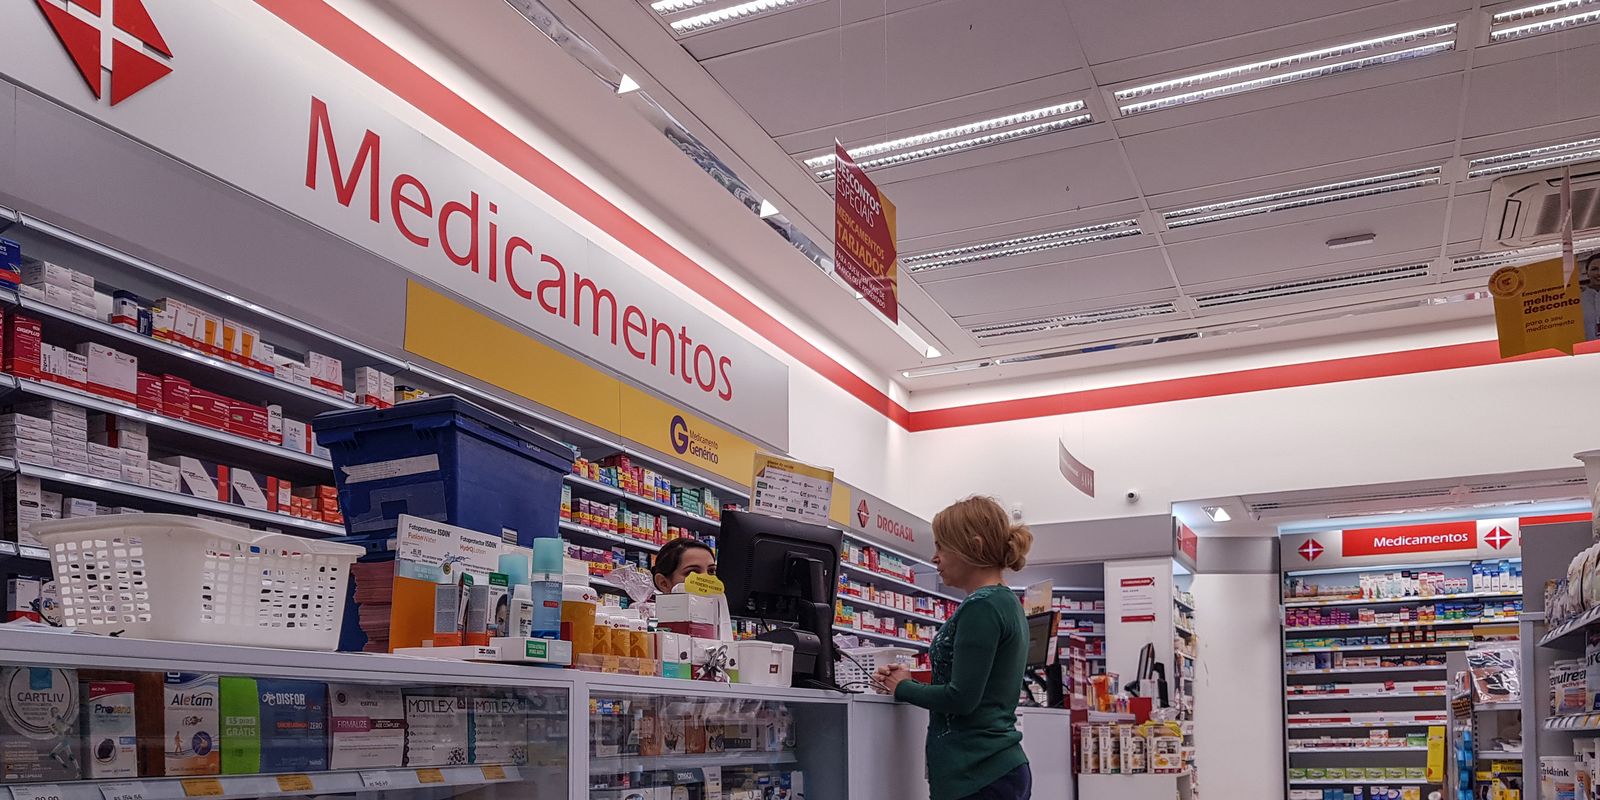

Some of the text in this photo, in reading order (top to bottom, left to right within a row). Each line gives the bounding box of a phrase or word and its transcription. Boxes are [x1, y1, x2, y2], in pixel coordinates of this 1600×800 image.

[836, 172, 874, 228] ESPECIAIS
[836, 203, 885, 260] MEDICAMENTOS
[305, 95, 732, 401] Medicamentos
[837, 221, 885, 278] TARJADOS
[1523, 292, 1566, 307] melhor
[1524, 298, 1581, 314] desconto
[1525, 319, 1543, 329] para
[1526, 319, 1575, 333] medicamento
[670, 415, 689, 454] G
[689, 429, 719, 450] Medicamento
[689, 440, 719, 465] Genérico
[876, 514, 915, 542] DROGASIL
[1373, 532, 1469, 548] Medicamentos
[17, 692, 65, 703] CARTLIV
[170, 692, 213, 707] Aletam
[276, 692, 306, 705] DISFOR
[226, 726, 256, 737] GRÁTIS
